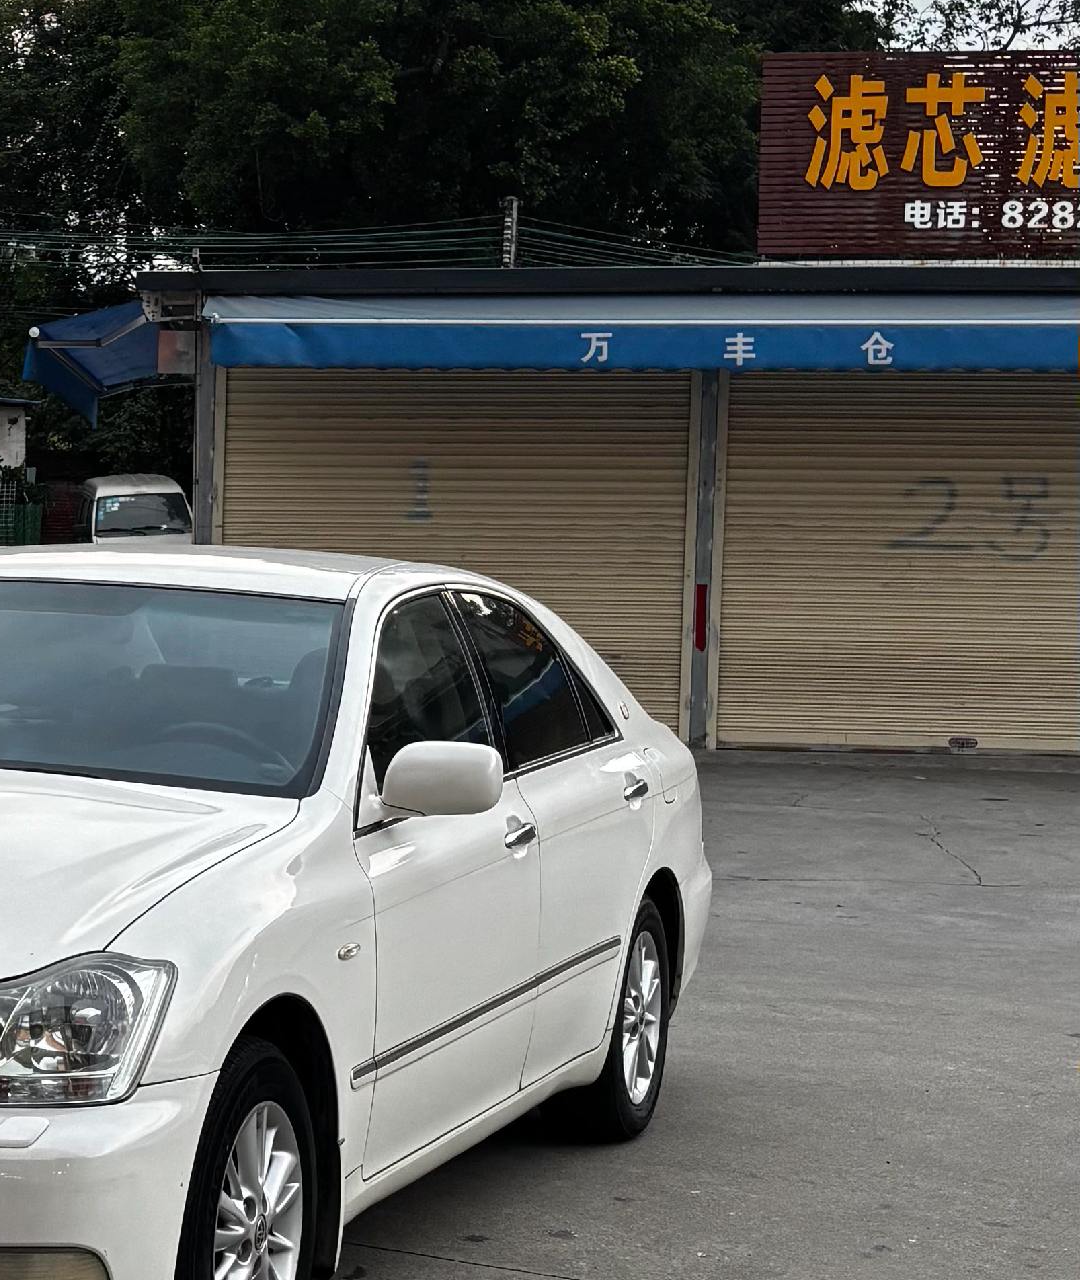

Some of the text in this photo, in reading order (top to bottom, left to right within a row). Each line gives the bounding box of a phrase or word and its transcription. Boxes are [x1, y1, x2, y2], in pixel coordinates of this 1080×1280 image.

[904, 200, 1080, 229] 电话：828
[580, 331, 894, 366] 万丰仓
